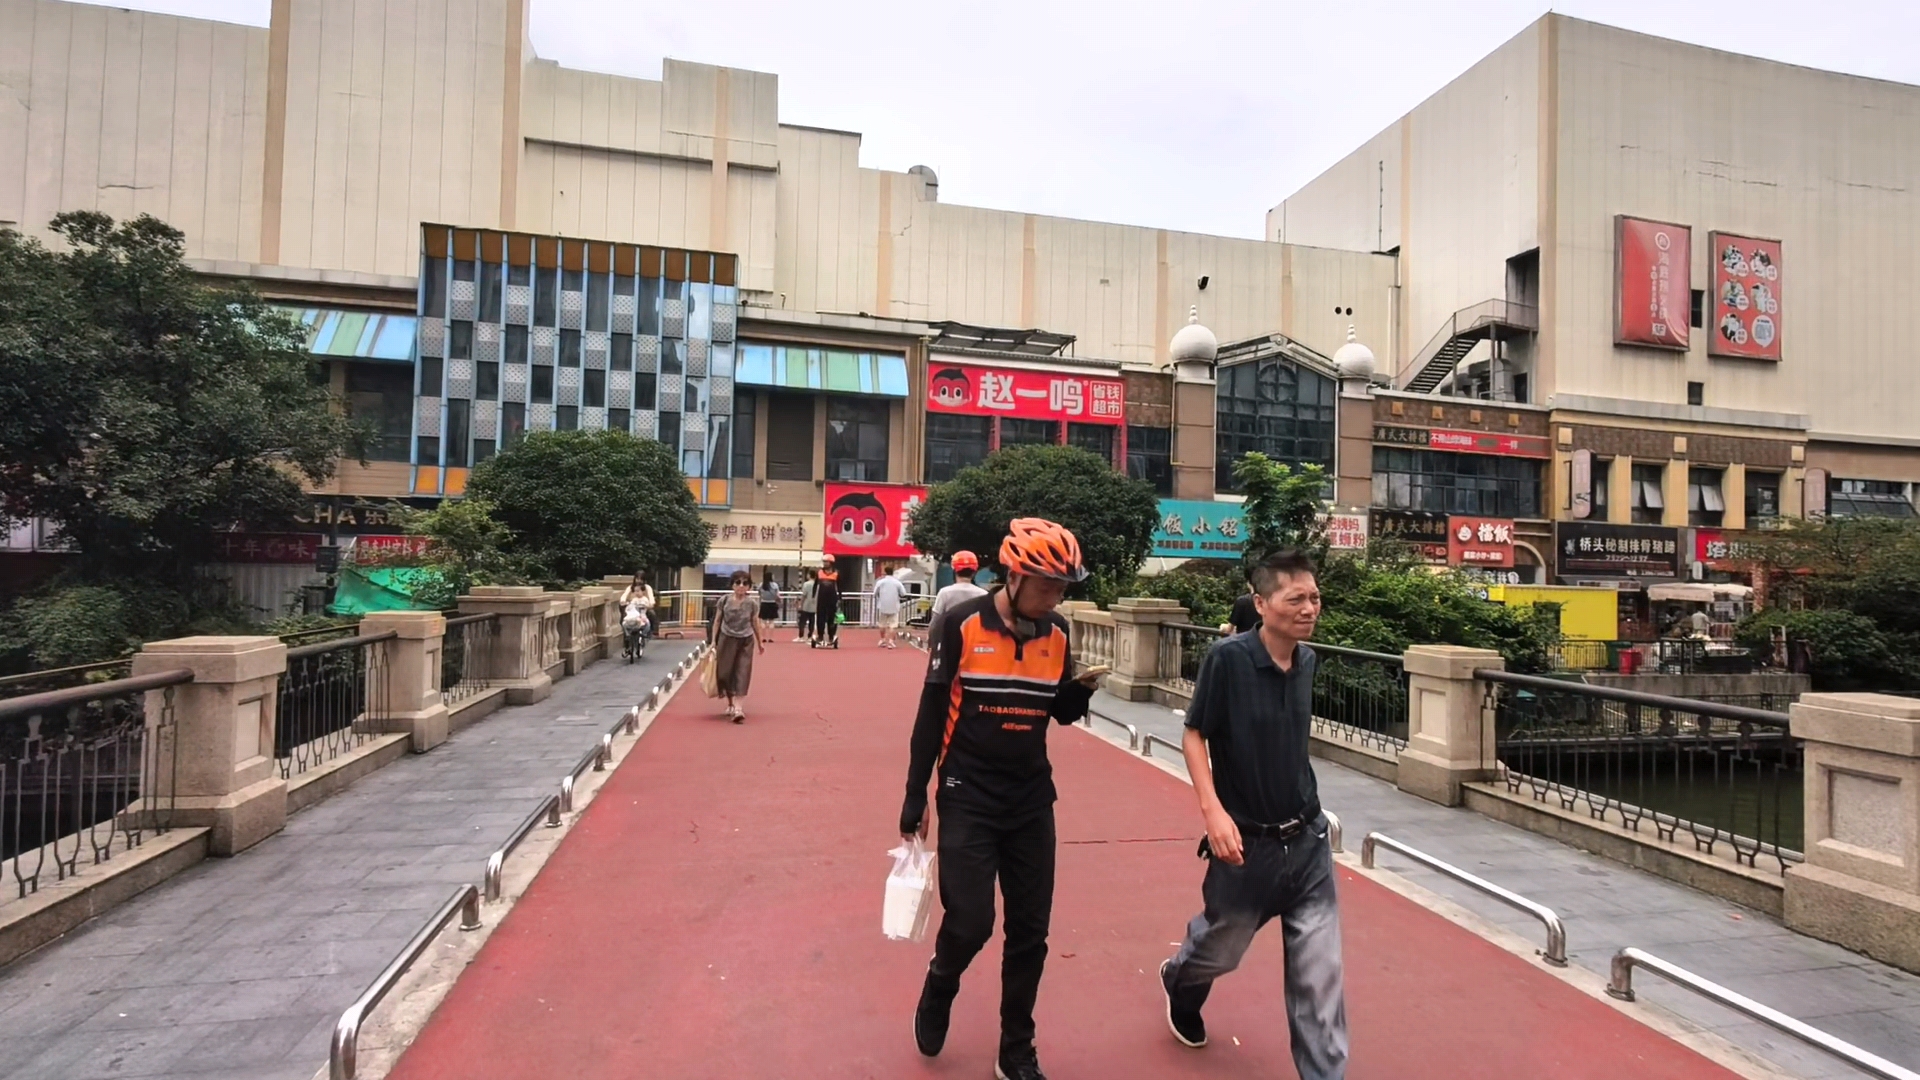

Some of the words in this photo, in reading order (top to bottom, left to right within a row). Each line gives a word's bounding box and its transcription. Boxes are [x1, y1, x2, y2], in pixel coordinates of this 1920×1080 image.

[977, 371, 1084, 415] 赵一鸣
[1092, 384, 1120, 399] 省钱
[1092, 400, 1120, 416] 超市
[1163, 512, 1239, 537] 饭小铭
[1579, 537, 1676, 555] 桥头秘制排骨猪蹄
